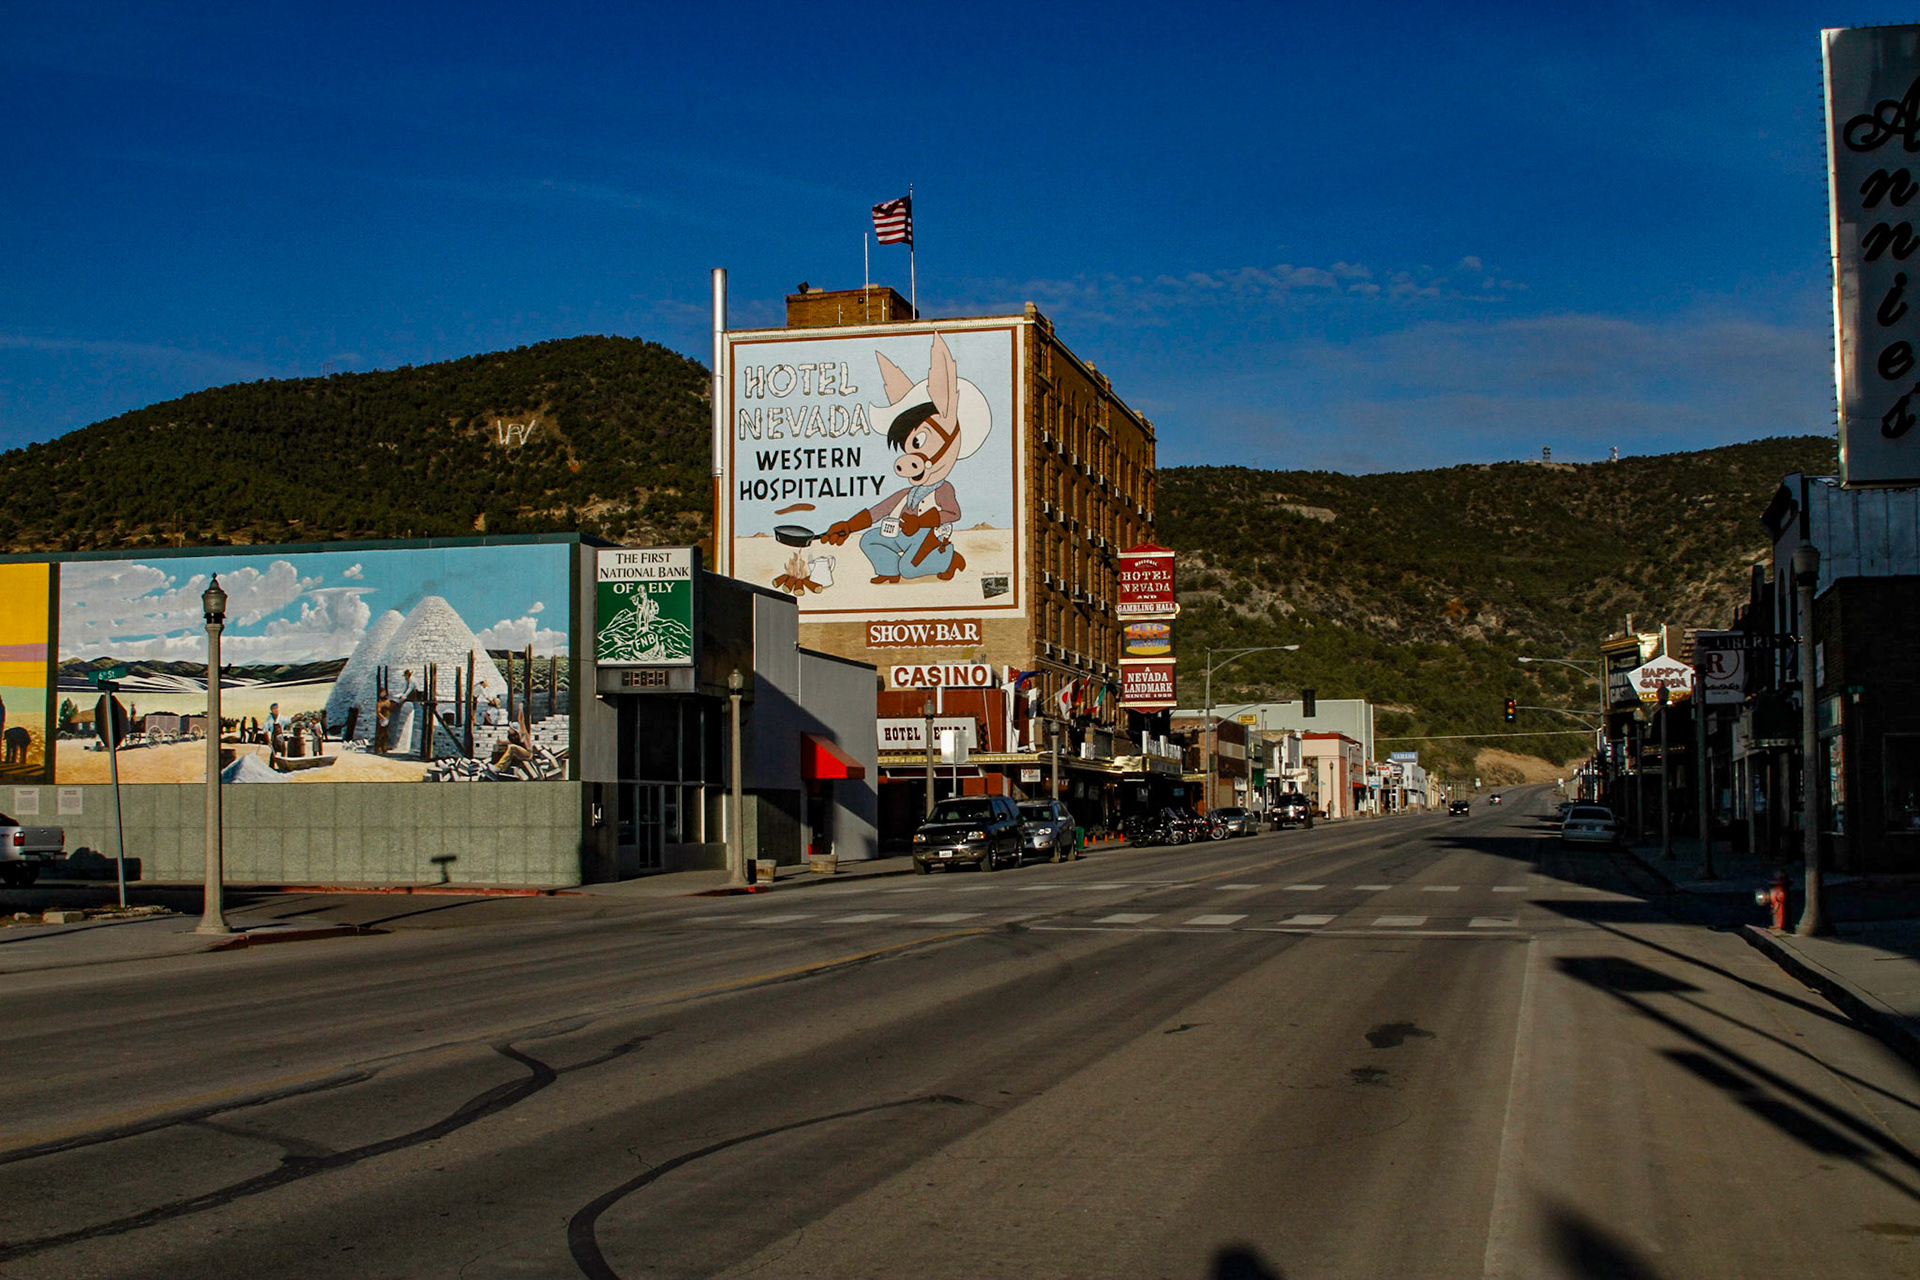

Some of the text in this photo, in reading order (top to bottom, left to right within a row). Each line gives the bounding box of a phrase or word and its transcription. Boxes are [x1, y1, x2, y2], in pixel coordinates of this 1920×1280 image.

[744, 361, 858, 399] HOTEL
[739, 403, 870, 440] NEVADA
[756, 447, 861, 471] WESTERN
[740, 475, 886, 501] HOSPITALITY
[616, 553, 672, 564] THE FIRST
[600, 566, 689, 579] NATIONAL BANK
[1121, 570, 1171, 581] HOTEL
[613, 582, 675, 594] OF ELY
[1121, 582, 1171, 593] NEVADA
[1117, 603, 1175, 612] GAMBLING HALL
[1131, 623, 1163, 631] PETS
[634, 633, 657, 650] FNB
[894, 665, 987, 687] CASINO
[1127, 672, 1169, 683] NEVADA
[1642, 667, 1688, 679] HAPPY
[1124, 682, 1173, 693] LANDMARK
[884, 727, 921, 741] HOTEL
